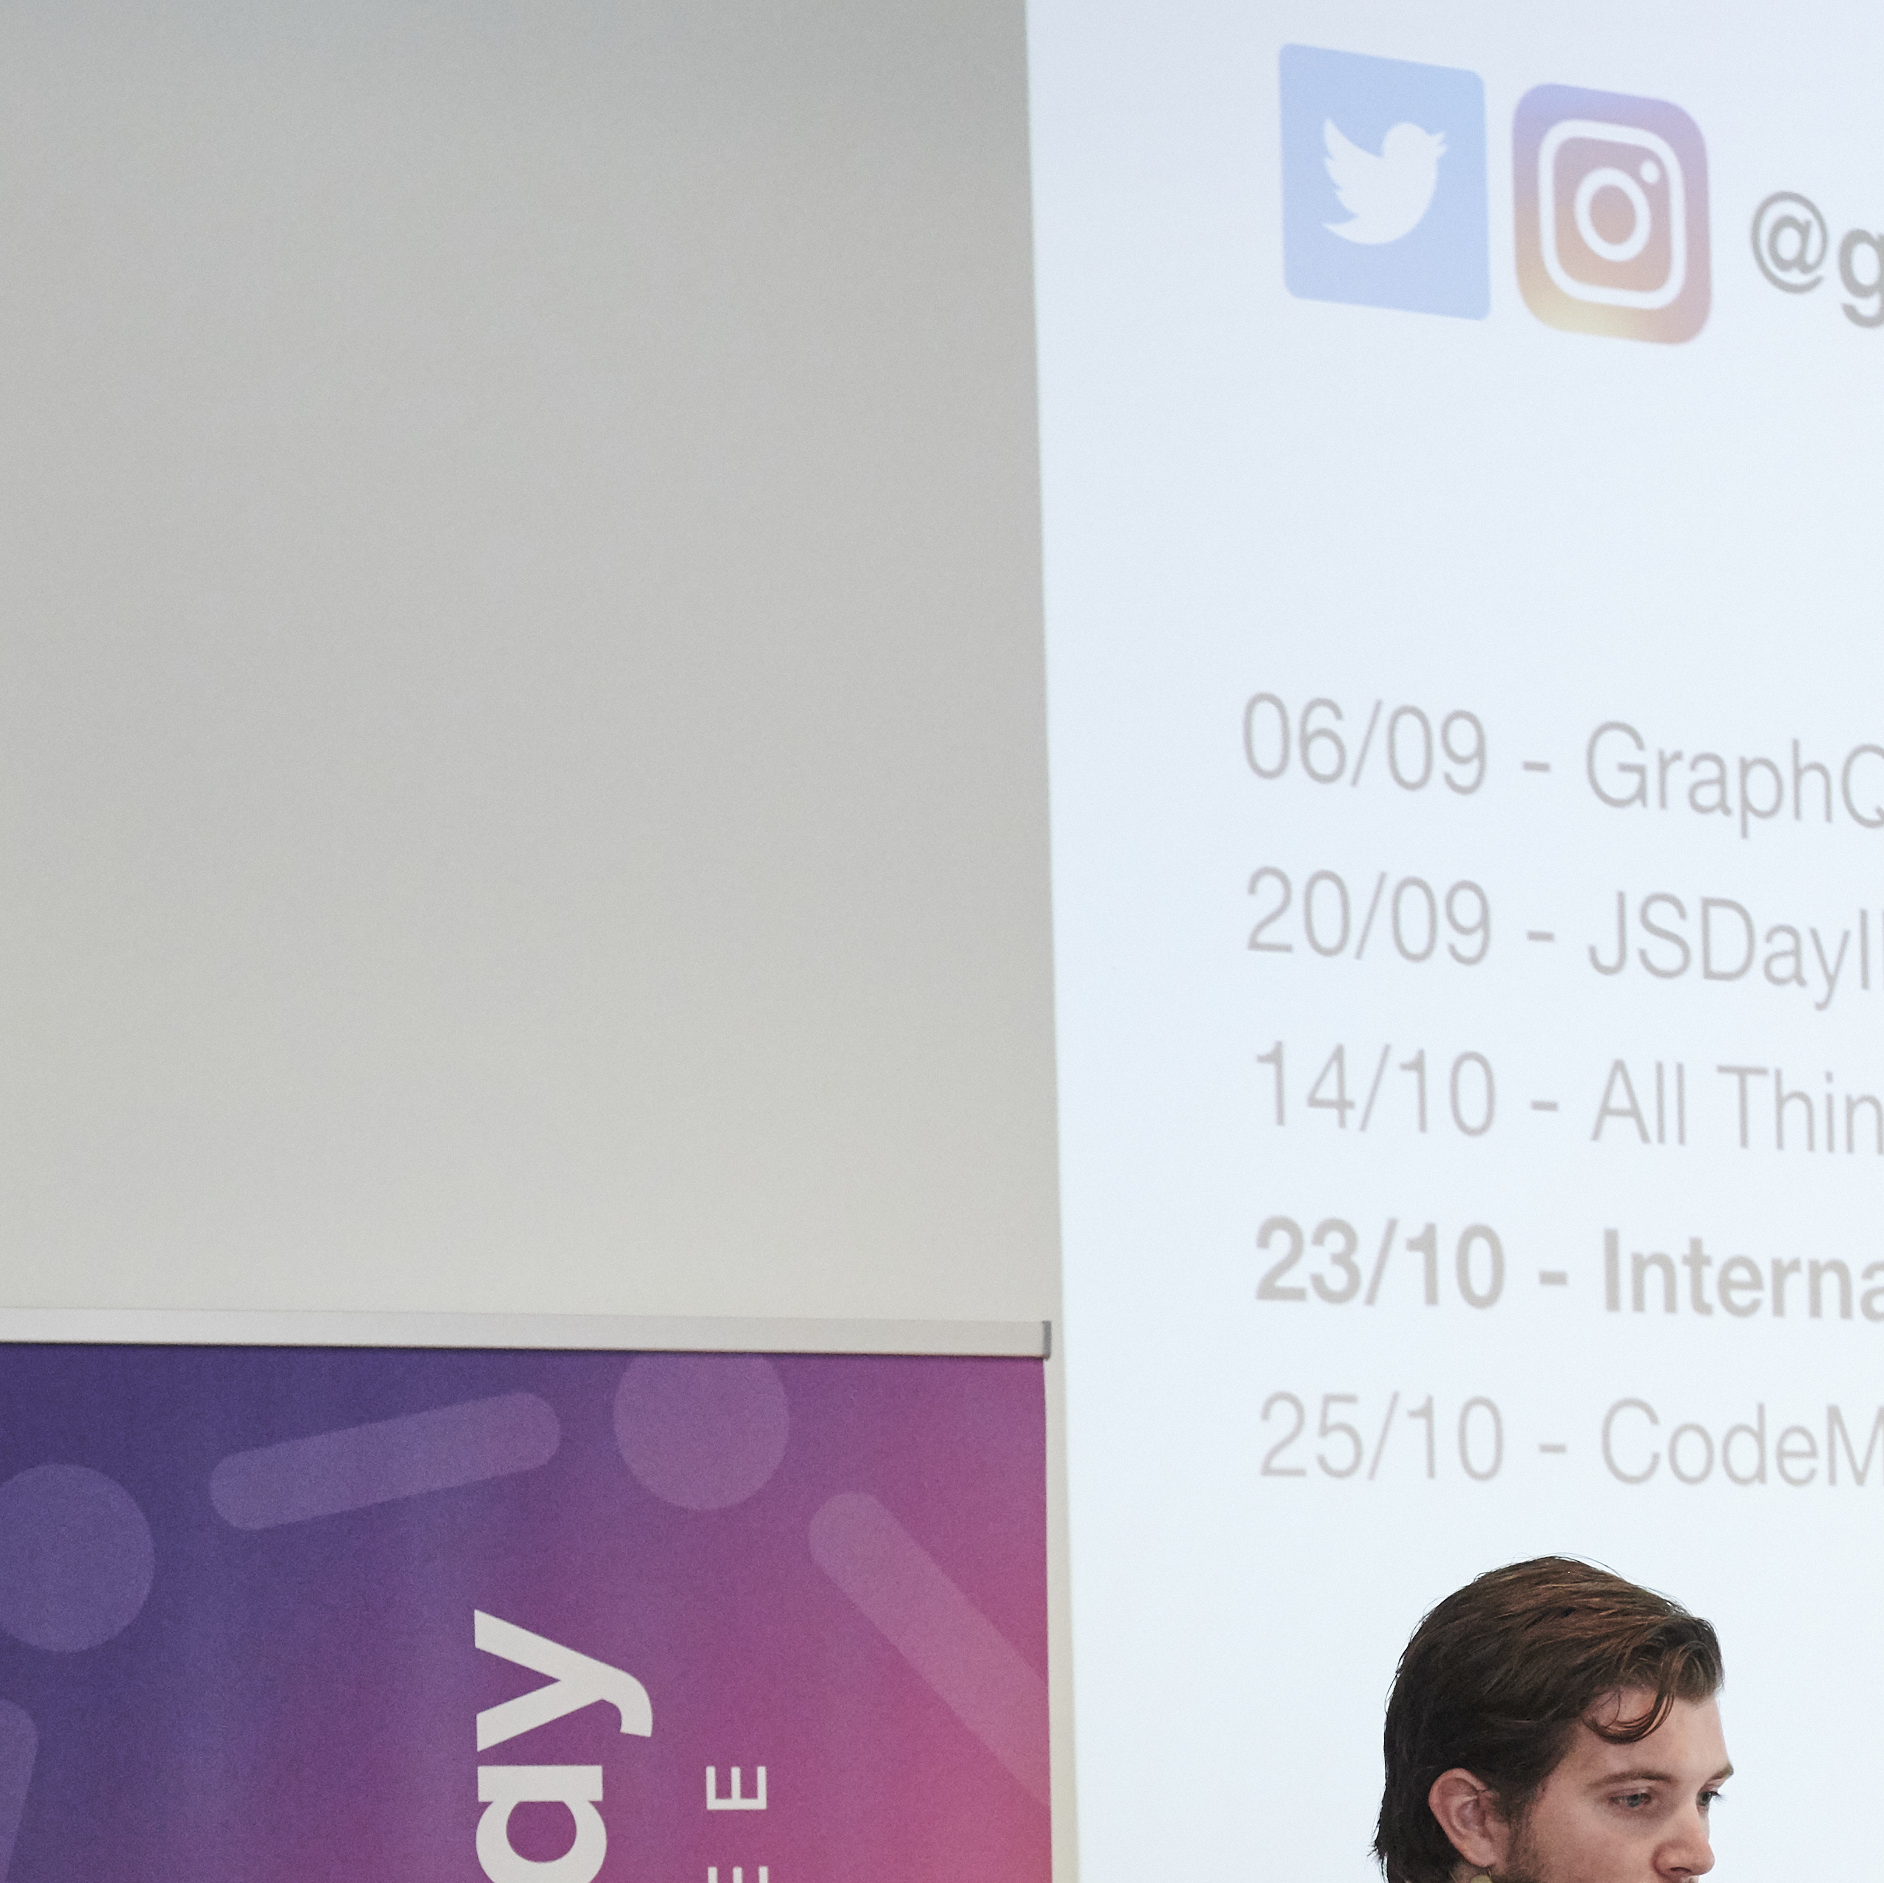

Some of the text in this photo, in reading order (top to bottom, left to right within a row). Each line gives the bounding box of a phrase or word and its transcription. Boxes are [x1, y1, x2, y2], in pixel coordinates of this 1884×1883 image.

[1241, 691, 1488, 797] 06/09
[1246, 865, 1492, 967] 20/09
[1255, 1040, 1497, 1138] 14/10
[1590, 1058, 1687, 1147] All
[1255, 1214, 1507, 1311] 23/10
[1259, 1390, 1505, 1483] 25/10
